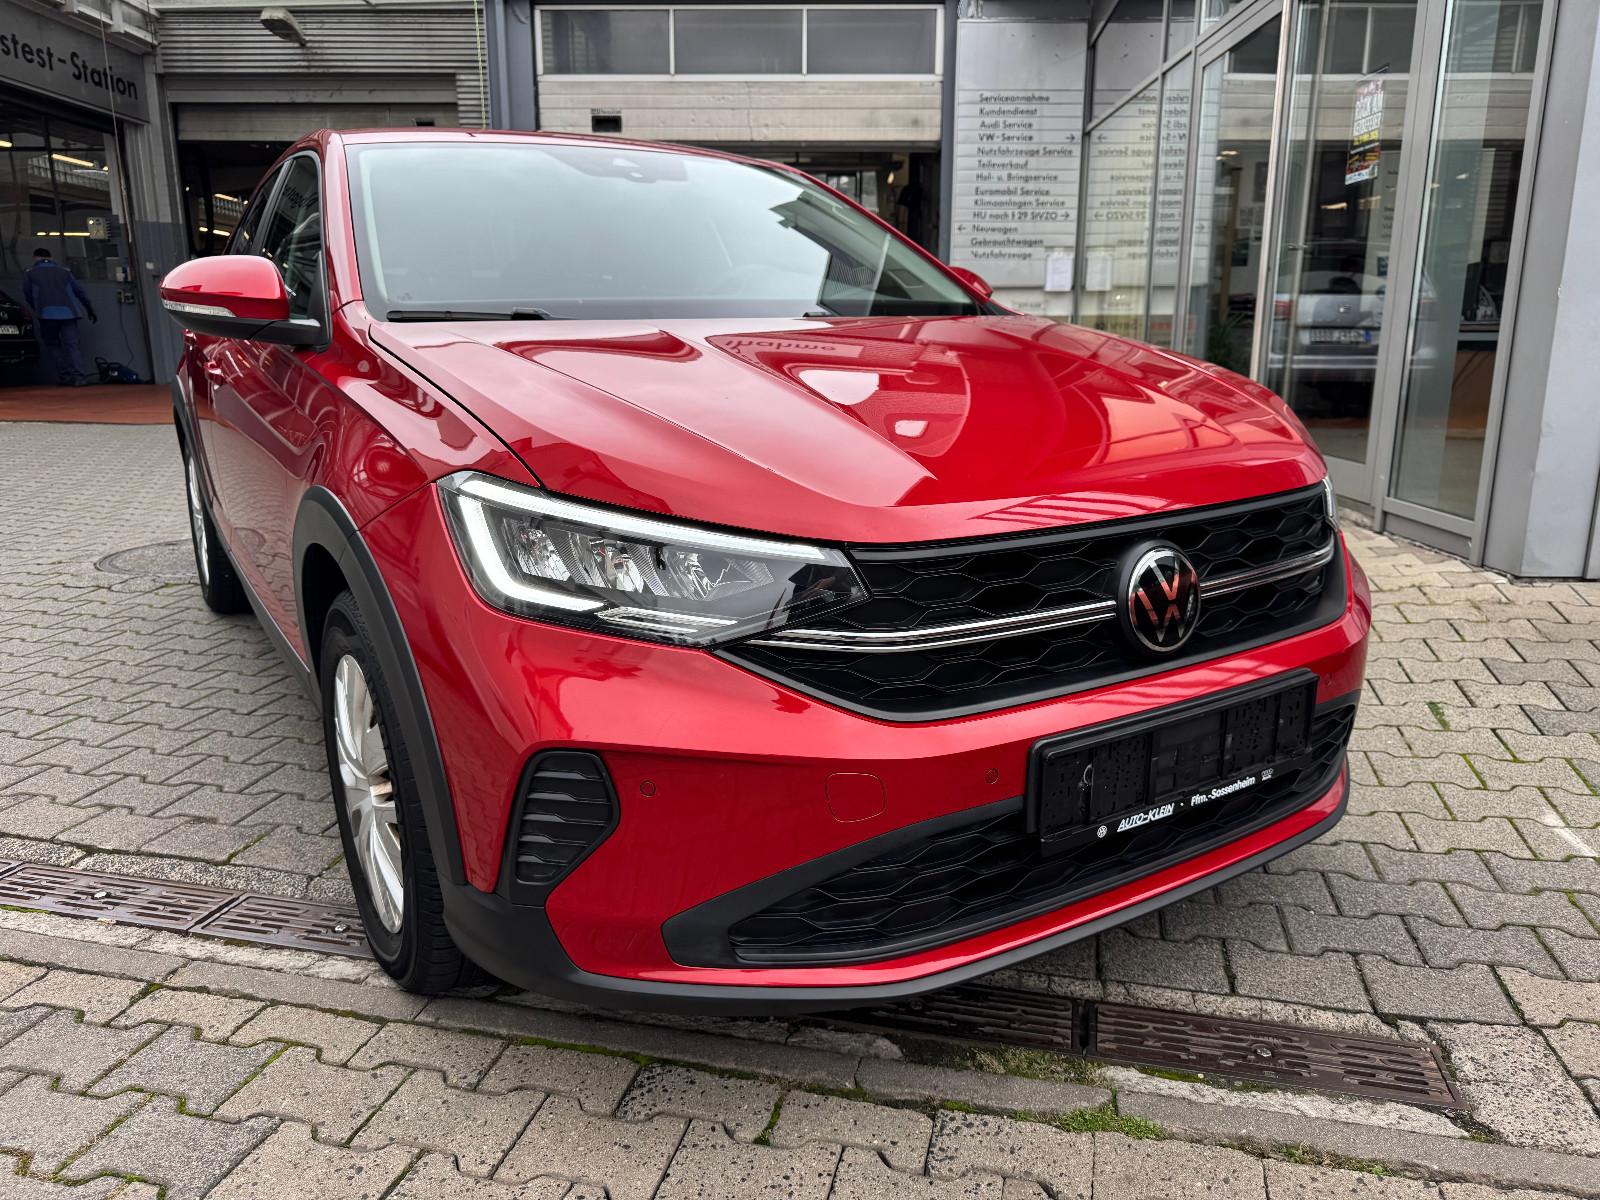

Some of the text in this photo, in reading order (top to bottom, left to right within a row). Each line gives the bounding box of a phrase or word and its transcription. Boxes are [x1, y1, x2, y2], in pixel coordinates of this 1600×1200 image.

[979, 92, 1050, 103] Serviceannahme
[979, 107, 1038, 116] Kundendienst
[980, 121, 1034, 130] Audi Service
[977, 147, 1073, 157] Nutzfahrzeuge Service
[978, 160, 1028, 169] Teileverkauf
[1006, 173, 1059, 183] Bringservice
[975, 186, 1051, 196] Euromobil Service
[973, 199, 1066, 209] Klimaanlagen Service
[972, 211, 986, 220] HU
[988, 211, 1010, 220] nach
[1017, 211, 1029, 220] 29
[971, 224, 1019, 235] Neuwagen
[970, 237, 1044, 248] Gebrauchtwagen
[1117, 803, 1175, 832] AUTO-KLEIN
